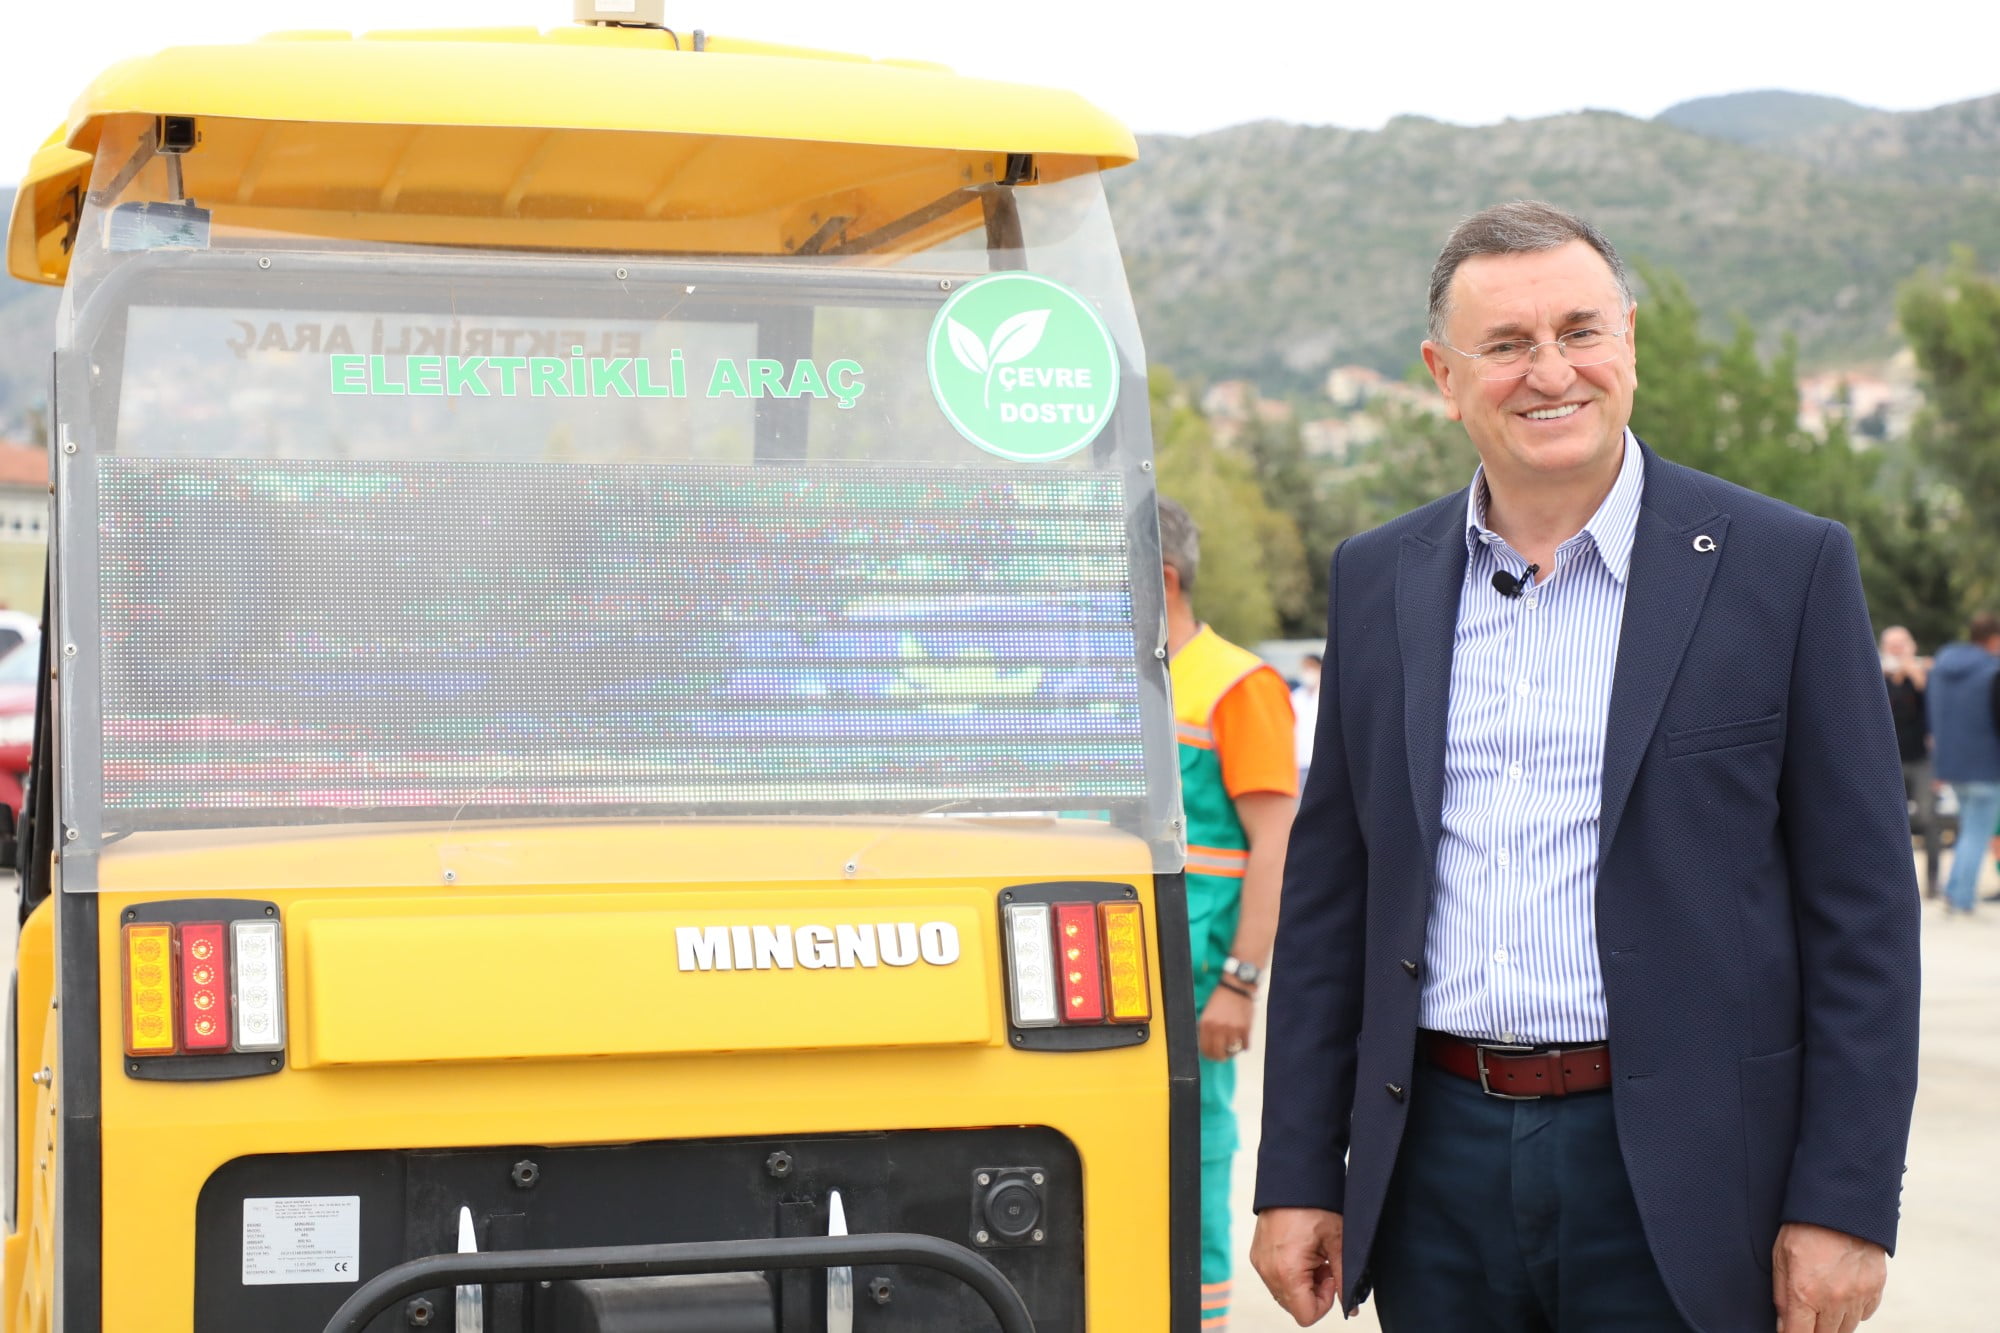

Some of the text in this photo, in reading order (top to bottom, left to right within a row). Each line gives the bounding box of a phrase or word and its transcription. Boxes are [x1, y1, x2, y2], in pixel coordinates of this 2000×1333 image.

[330, 345, 866, 410] ELEKTRİKLİ ARAÇ
[998, 366, 1092, 392] ÇEVRE
[1000, 403, 1096, 424] DOSTU
[675, 921, 960, 972] MINGNUO
[334, 1262, 348, 1272] CE
